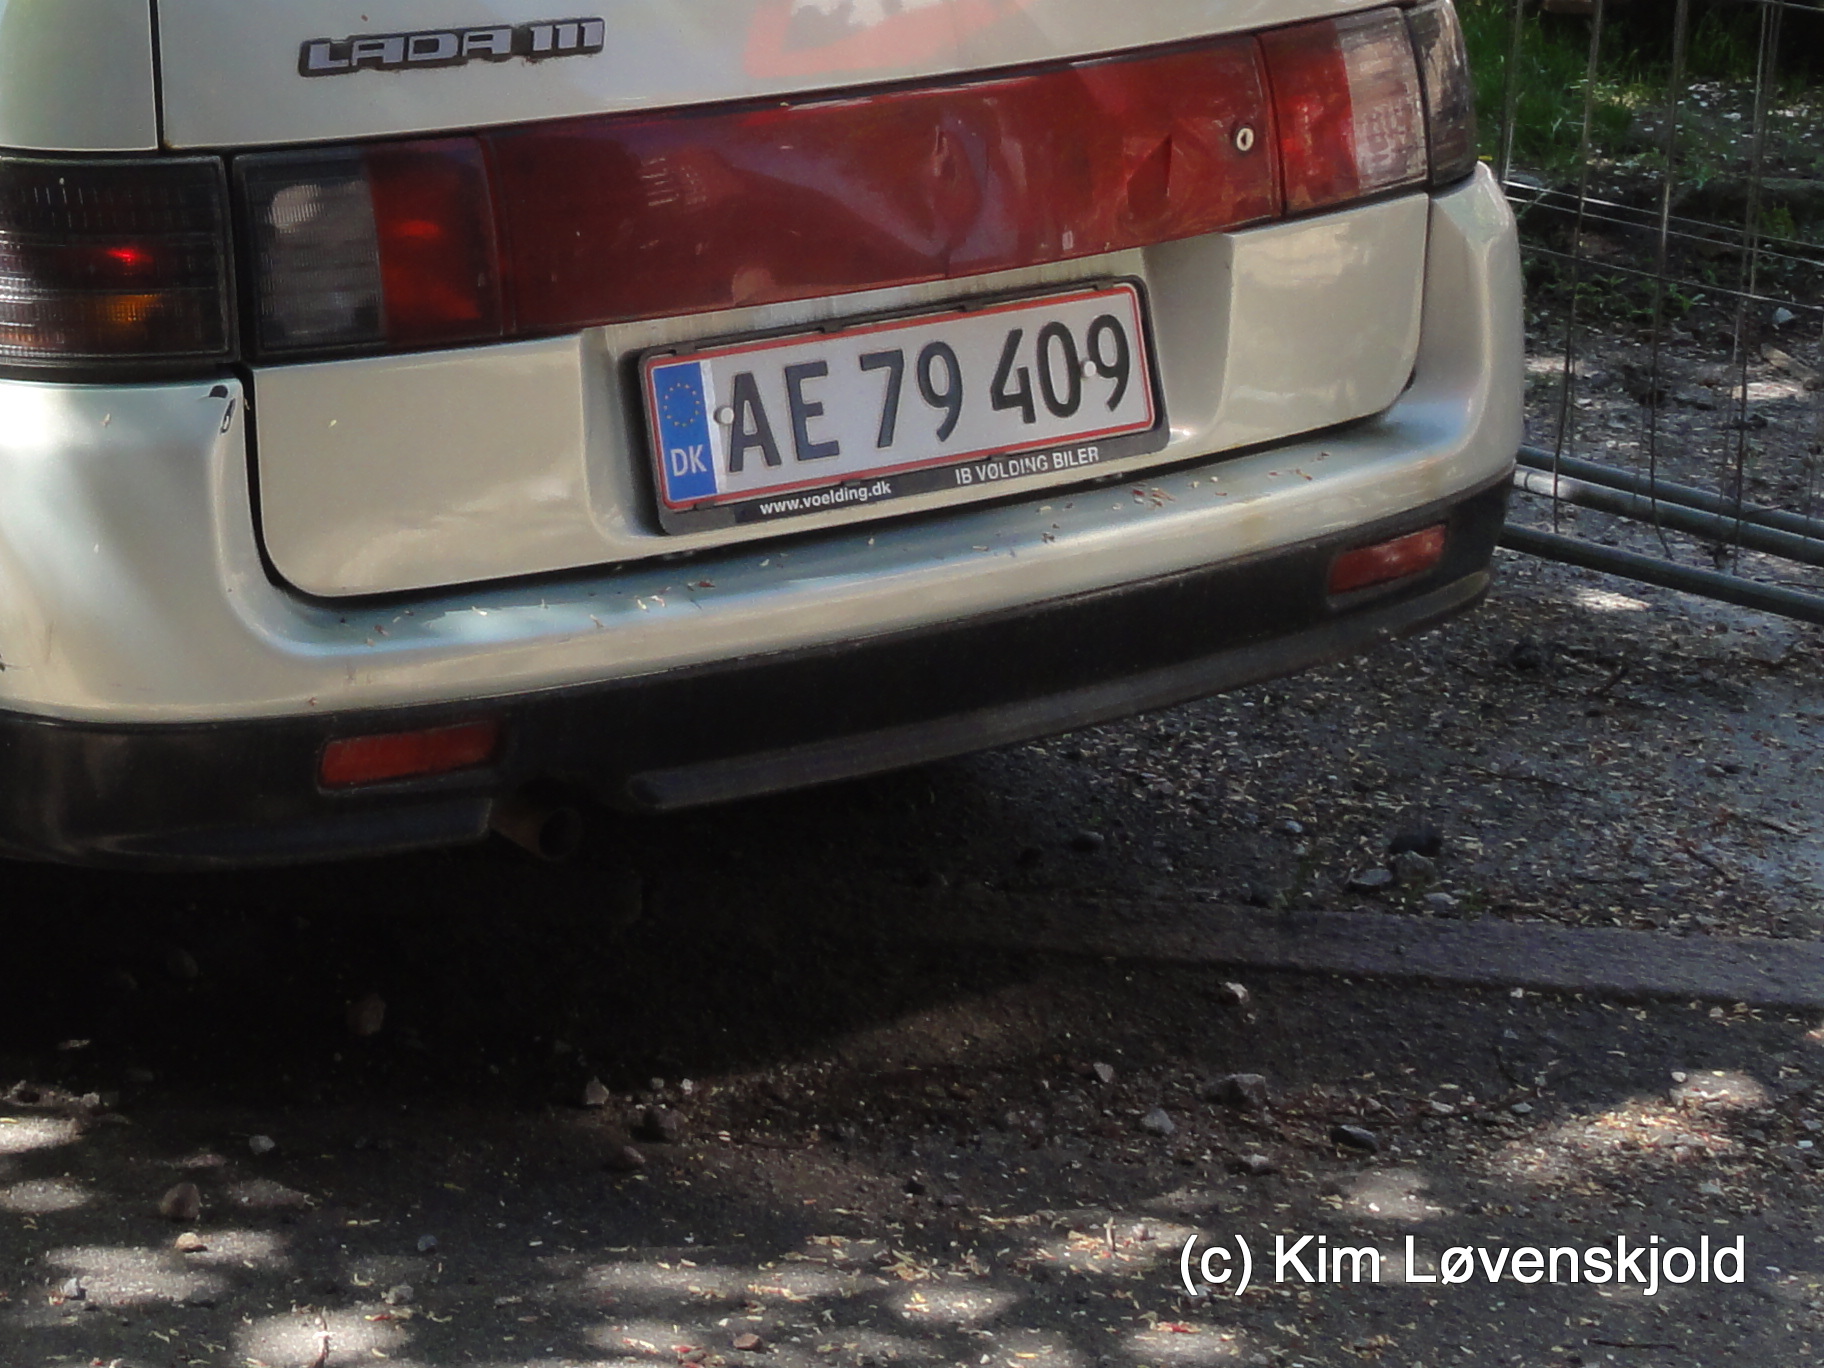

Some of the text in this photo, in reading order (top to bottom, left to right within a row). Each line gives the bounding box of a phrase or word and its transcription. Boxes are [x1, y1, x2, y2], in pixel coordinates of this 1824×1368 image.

[308, 28, 513, 70] LADA
[729, 314, 1130, 473] AE 79 409
[670, 444, 708, 478] DK
[955, 447, 1100, 485] IB VØLDING BILER
[759, 481, 892, 515] www.voelding.dk
